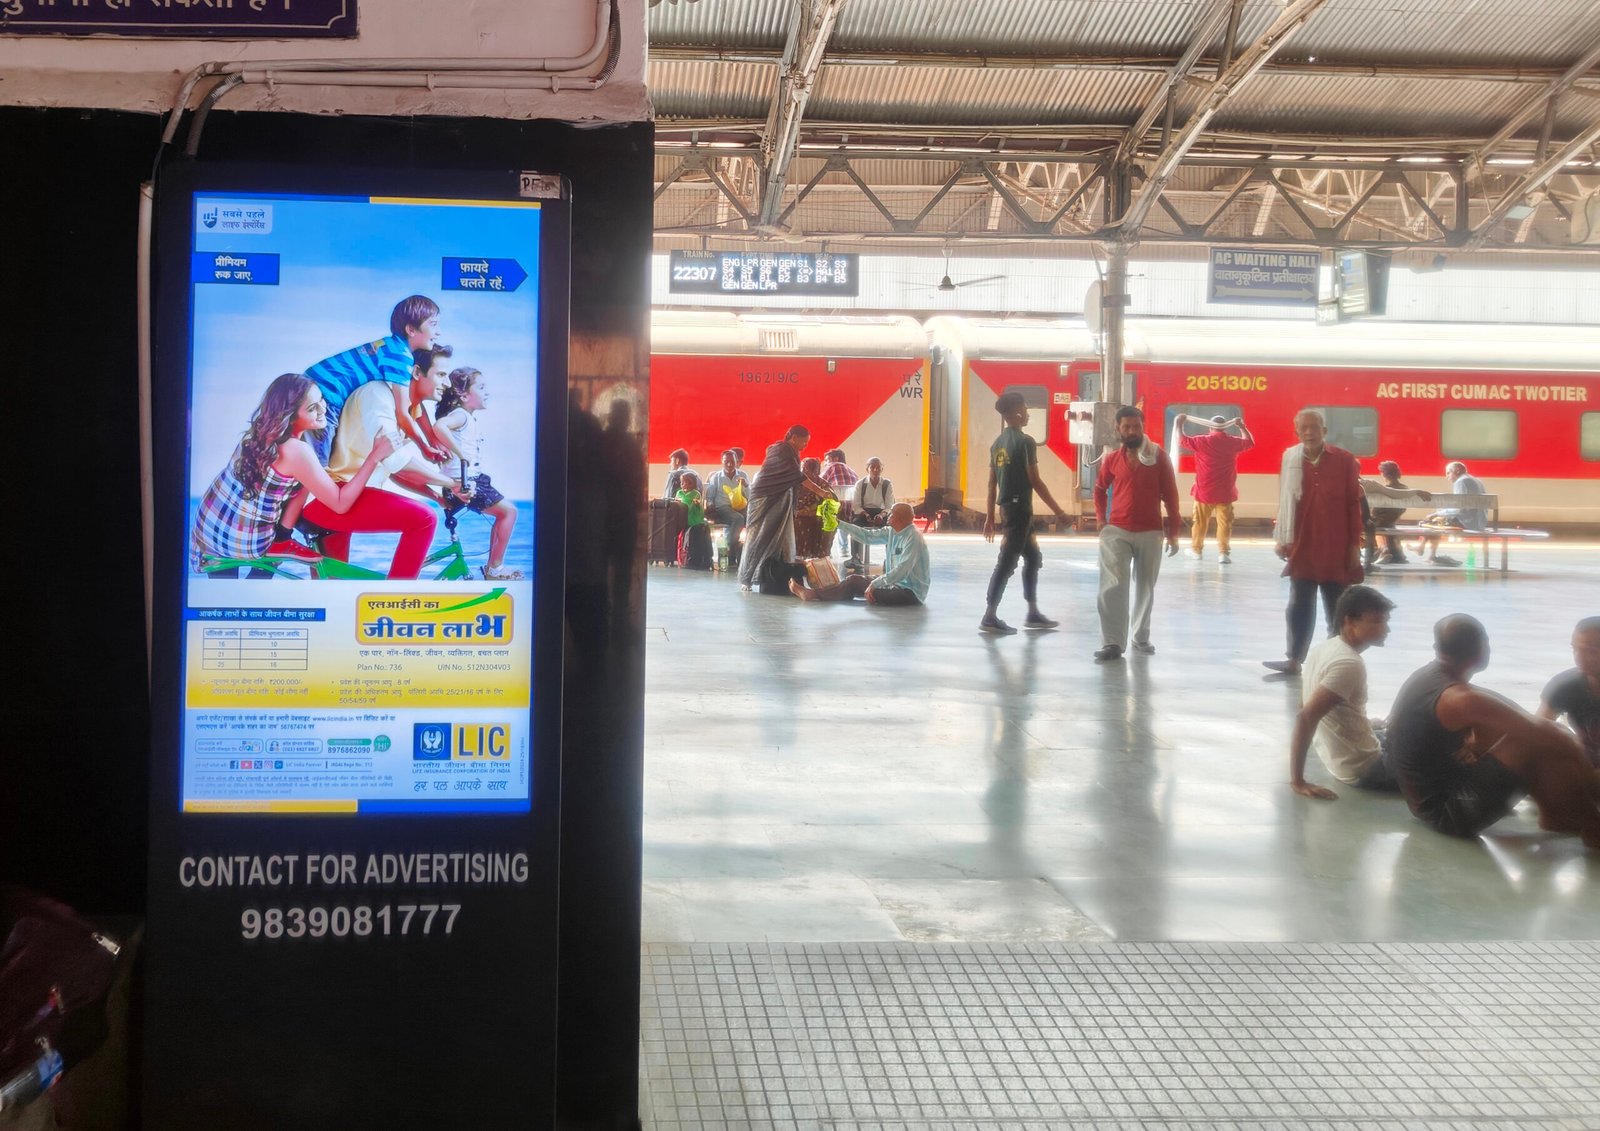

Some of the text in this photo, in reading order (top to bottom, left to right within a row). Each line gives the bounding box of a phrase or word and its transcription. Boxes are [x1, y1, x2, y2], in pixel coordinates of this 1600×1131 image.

[222, 208, 265, 219] सबसे पहले
[215, 256, 247, 268] प्रीमियम
[722, 258, 740, 267] ENG
[741, 259, 758, 267] LPR
[760, 259, 778, 268] GEN
[779, 260, 796, 268] GEN
[816, 260, 828, 268] S2
[1215, 252, 1316, 268] AC WAITING HALL
[674, 266, 717, 280] 22307
[741, 266, 753, 274] S5
[778, 267, 790, 275] PC
[460, 275, 486, 288] चलते
[722, 282, 778, 290] GEN GEN LPR
[778, 275, 790, 283] B2
[797, 275, 809, 283] B3
[816, 276, 828, 284] B4
[834, 276, 847, 284] B5
[739, 372, 799, 384] 196219/C
[1186, 375, 1268, 392] 205130/C
[900, 386, 924, 399] WR
[1376, 383, 1588, 402] AC FIRST CUM AC TWO TIER
[368, 599, 440, 610] एलआईसी का
[242, 609, 248, 618] के
[265, 610, 282, 618] जीवन
[362, 614, 507, 638] जीवन लाभ
[458, 726, 505, 757] LIC
[412, 761, 440, 769] भारतीय
[414, 778, 508, 792] हर पल आपके साथ
[179, 852, 529, 888] CONTACT FOR ADVERTISING
[241, 904, 462, 939] 9839081777
